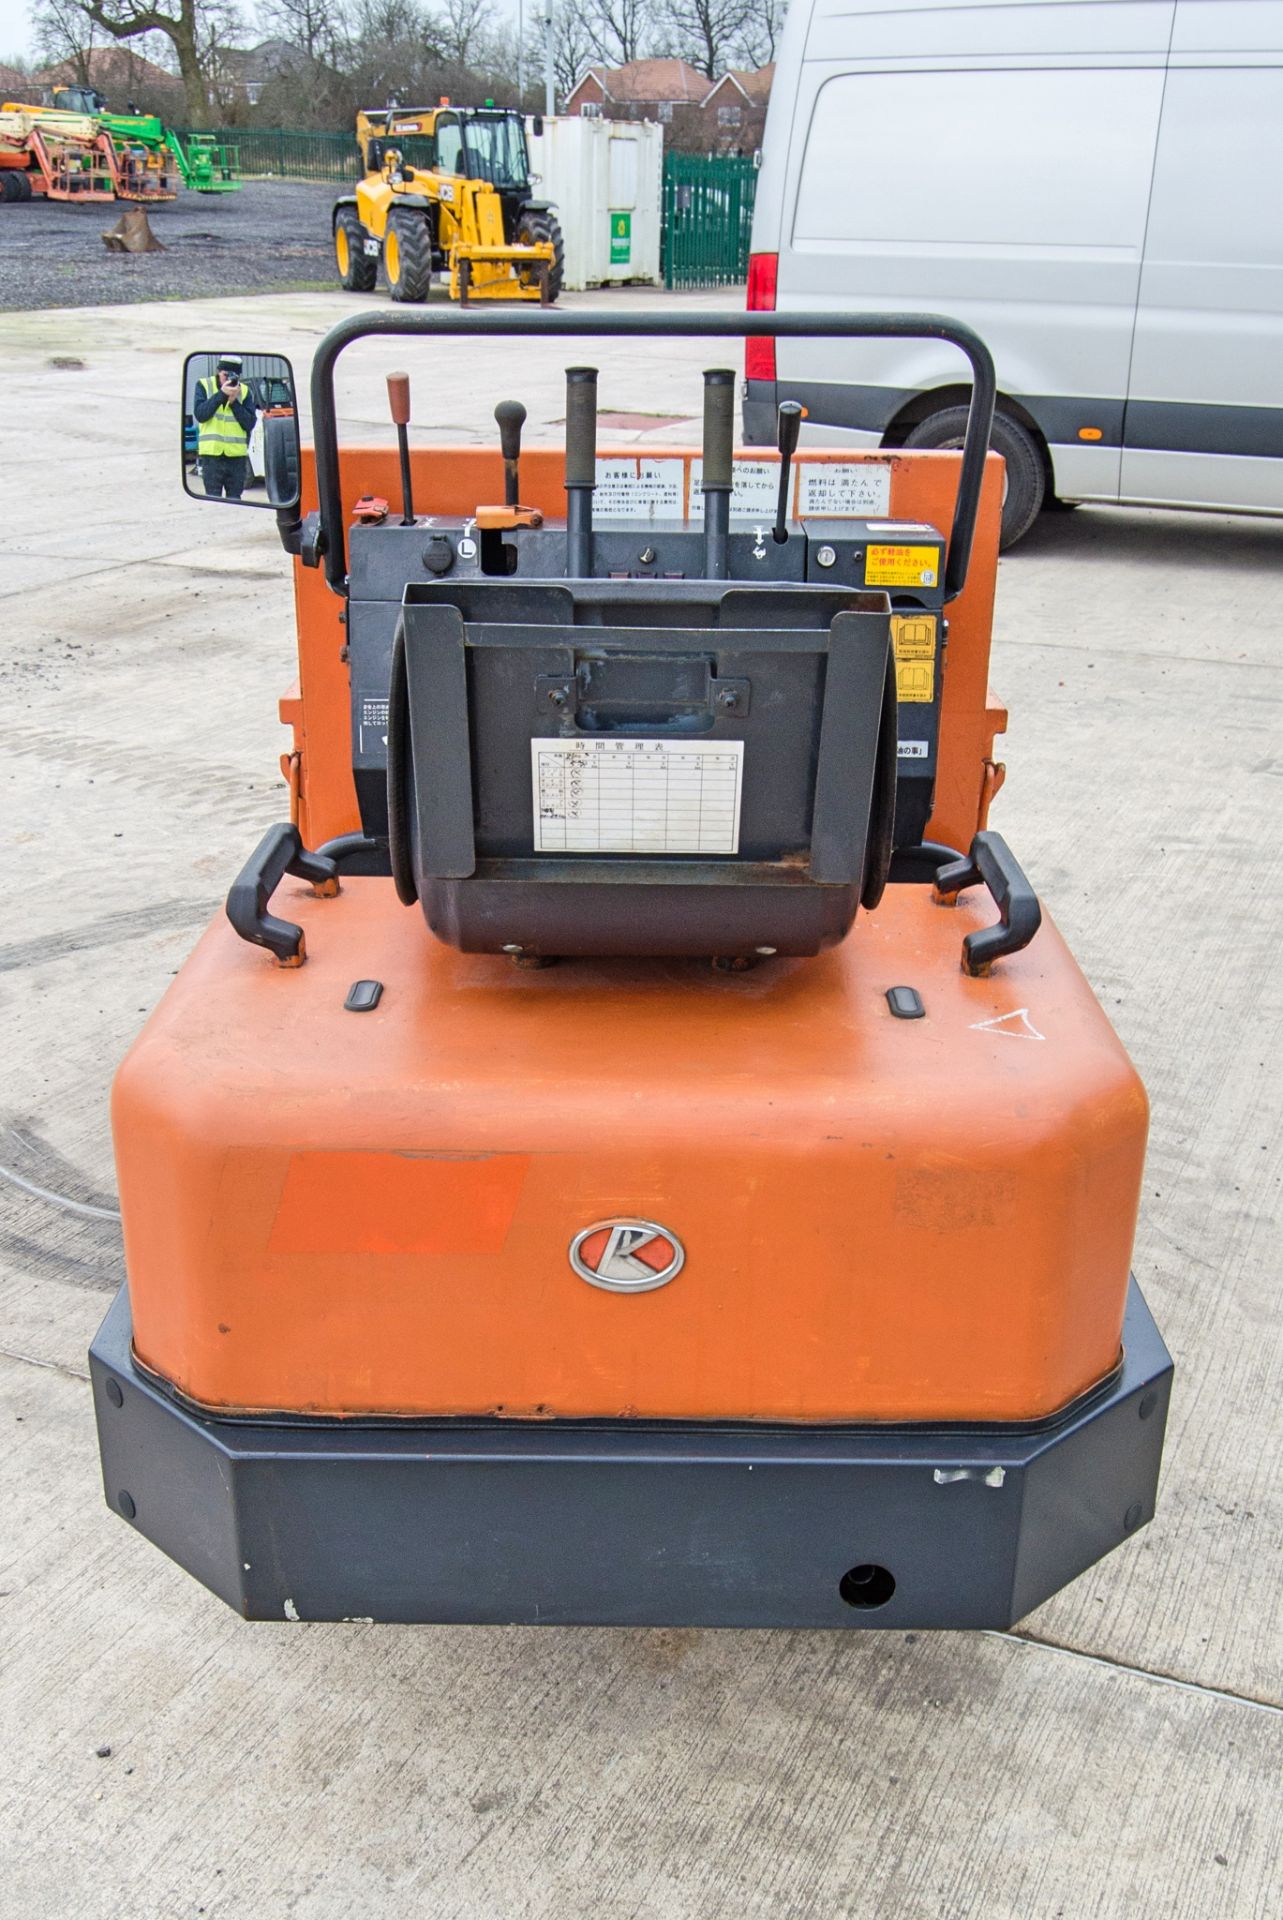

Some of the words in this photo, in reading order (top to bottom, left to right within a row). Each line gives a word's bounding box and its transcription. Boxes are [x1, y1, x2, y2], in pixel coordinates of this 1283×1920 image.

[462, 542, 473, 556] L
[575, 741, 664, 751] 時間管理表
